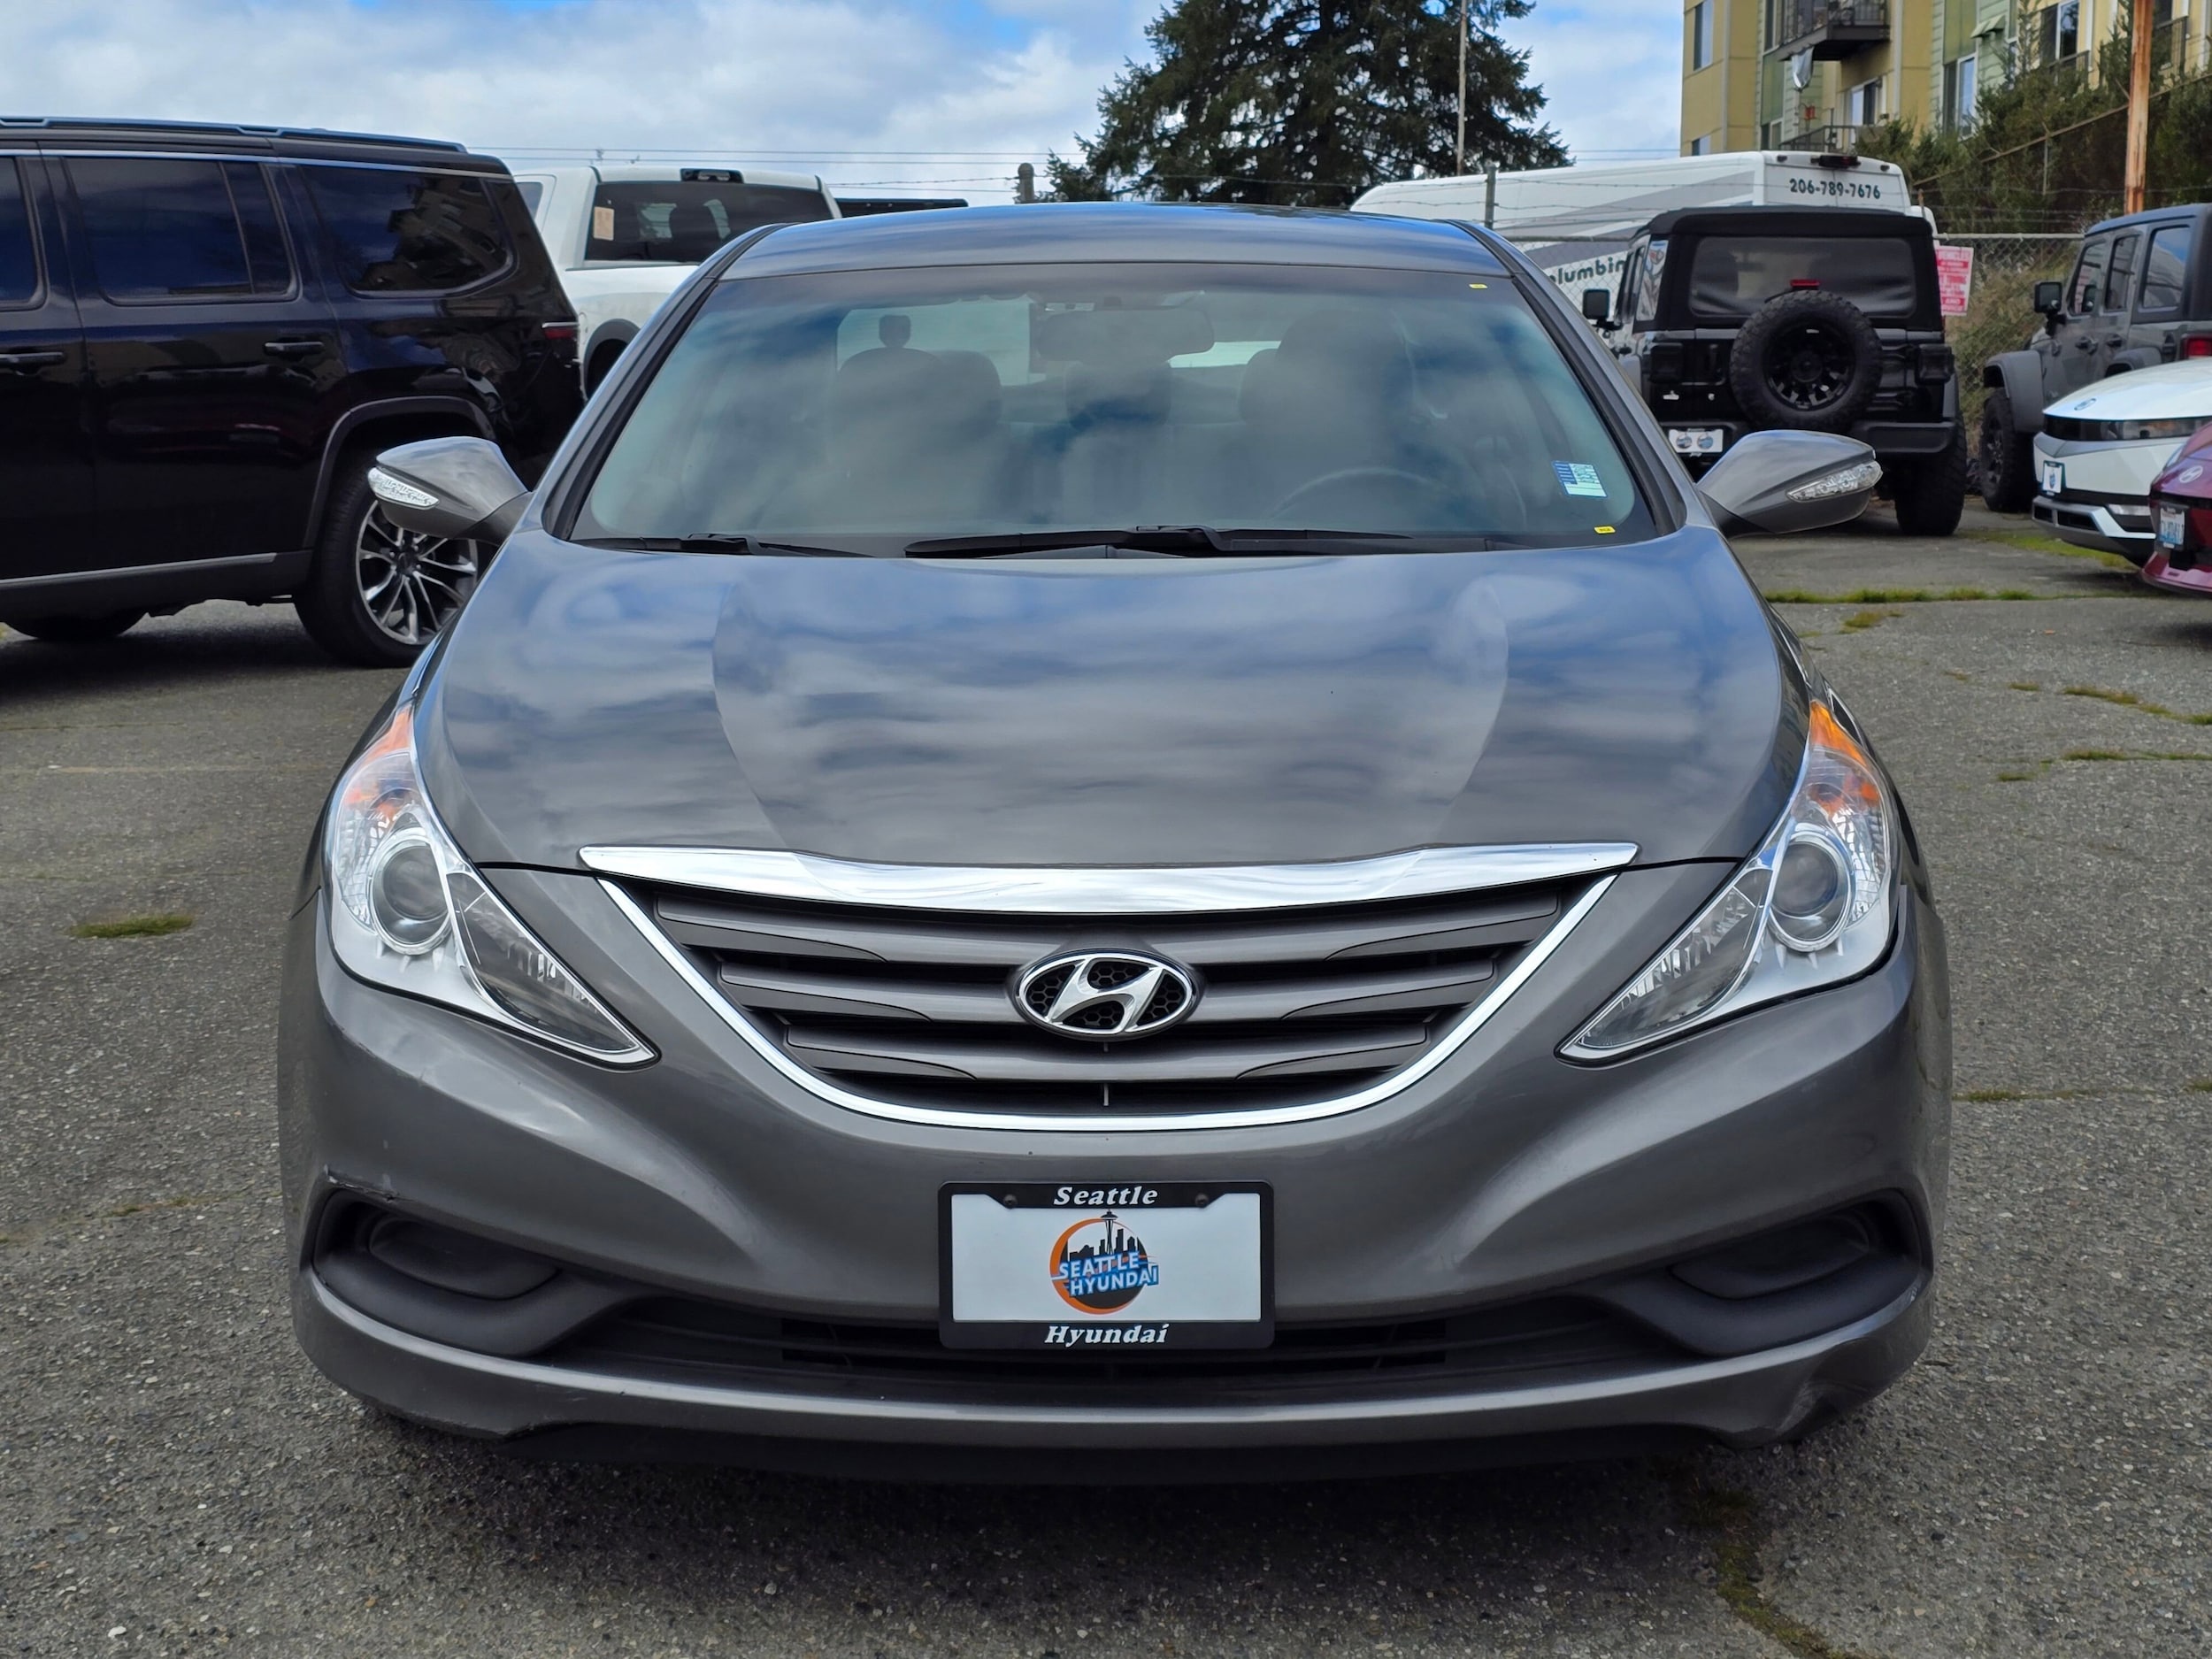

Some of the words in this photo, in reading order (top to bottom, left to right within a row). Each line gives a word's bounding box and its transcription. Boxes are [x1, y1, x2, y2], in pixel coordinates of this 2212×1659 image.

[1789, 178, 1881, 200] 206-789-7676
[1053, 1186, 1158, 1205] Seattle
[1058, 1251, 1141, 1280] SEATTLE
[1070, 1267, 1158, 1296] HYUNDAI
[1044, 1324, 1170, 1348] Hyundai
